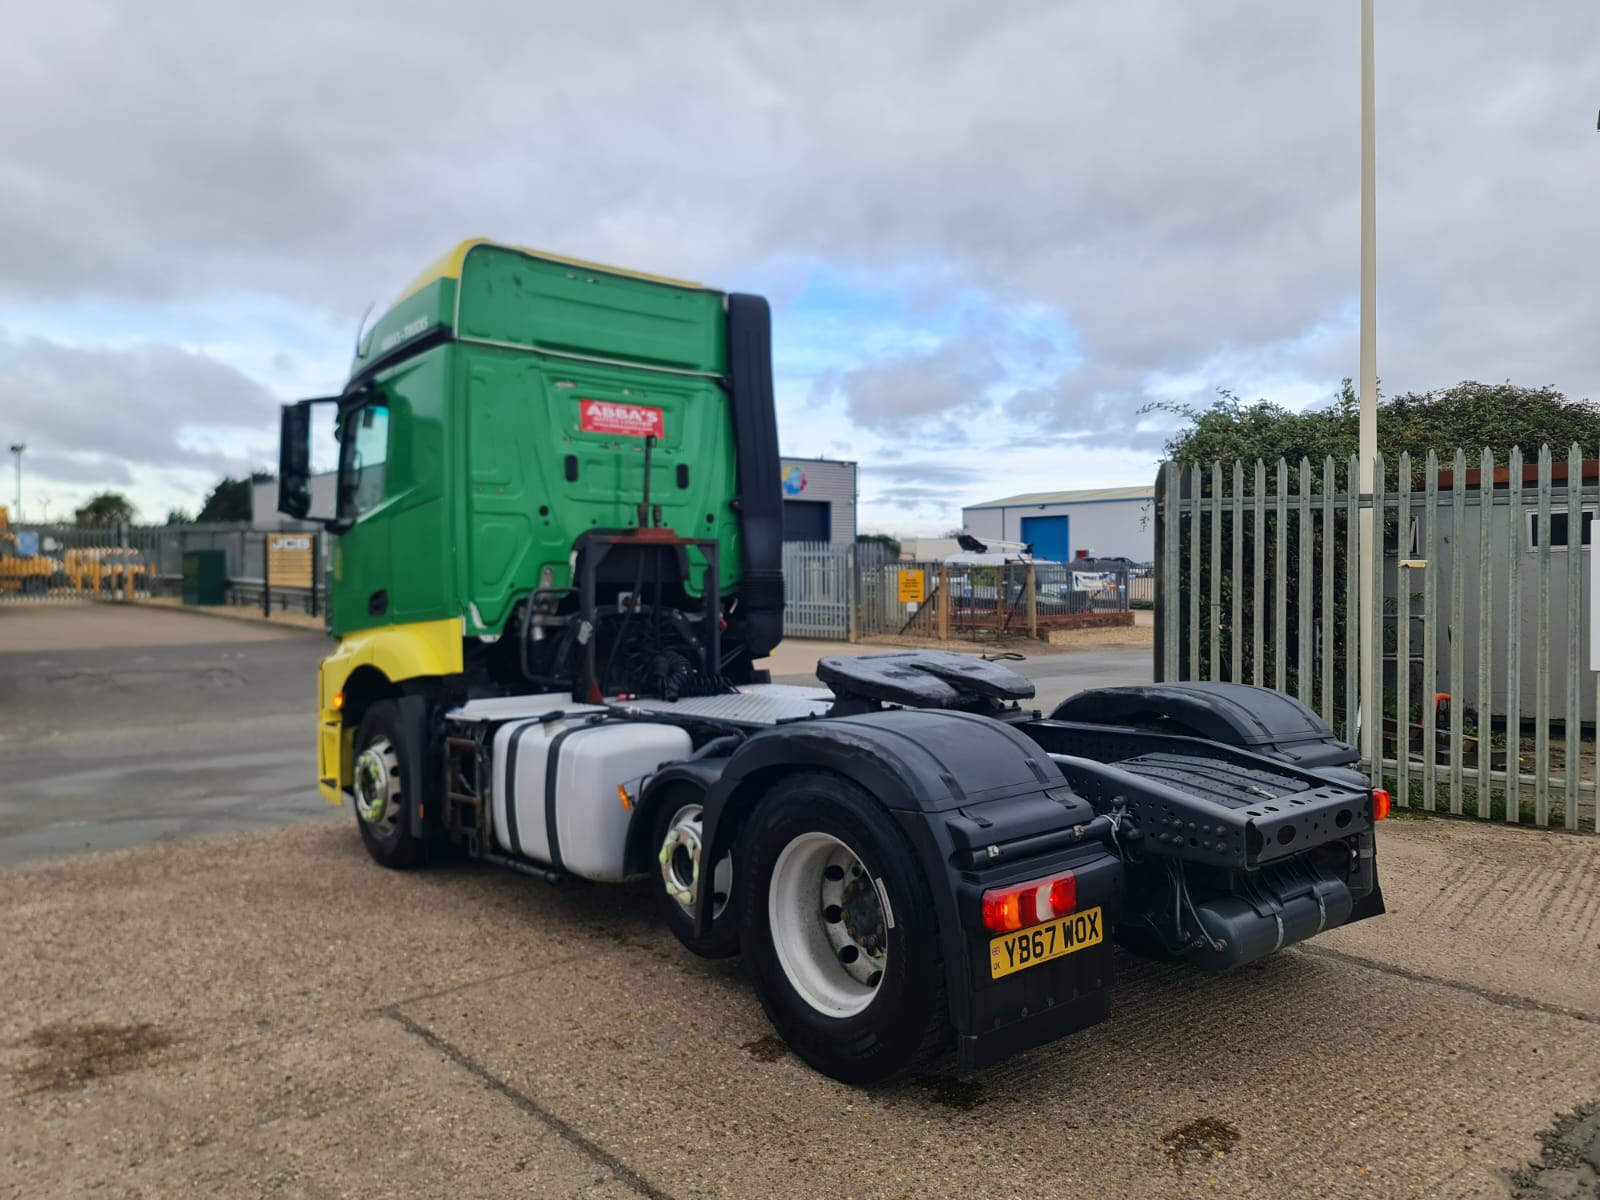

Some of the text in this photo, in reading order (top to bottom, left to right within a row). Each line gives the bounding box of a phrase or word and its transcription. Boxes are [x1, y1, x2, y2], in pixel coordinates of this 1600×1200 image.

[587, 404, 658, 423] ABBA'S
[272, 538, 309, 551] JCB
[1004, 912, 1099, 968] YB67 WOX
